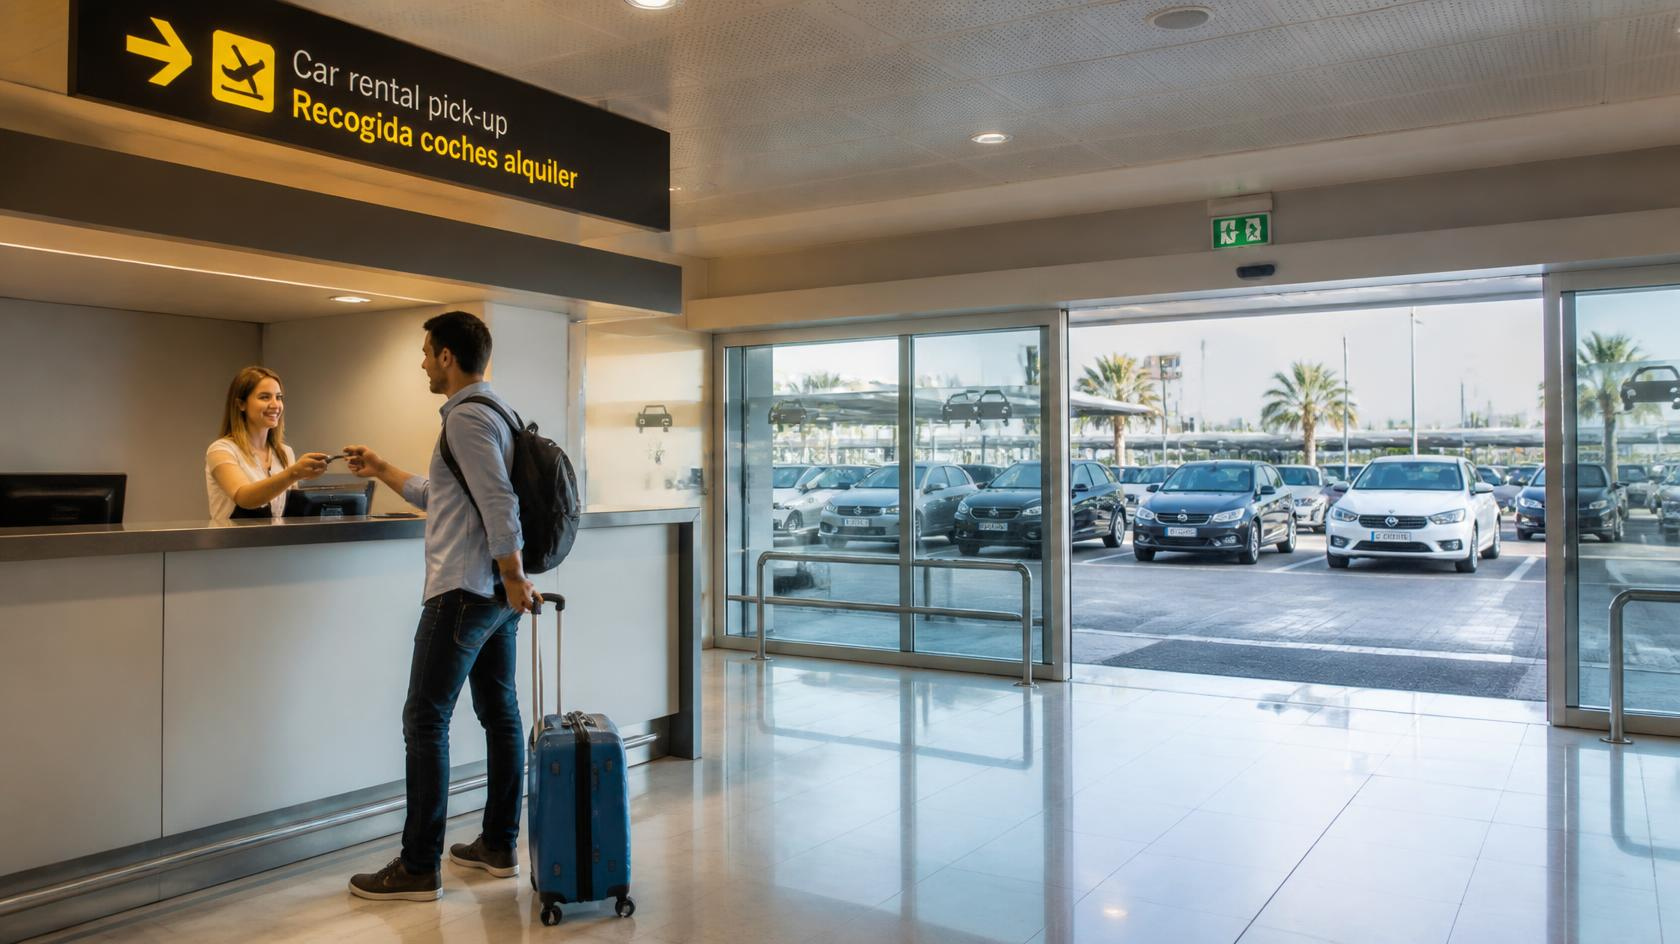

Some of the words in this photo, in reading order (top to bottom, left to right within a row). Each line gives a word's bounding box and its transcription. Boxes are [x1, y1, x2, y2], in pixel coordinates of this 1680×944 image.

[292, 88, 413, 147] Recogida
[420, 132, 499, 169] coches
[503, 149, 579, 190] alquiler
[293, 49, 340, 87] Car
[349, 71, 420, 111] rental
[428, 94, 508, 140] pick-up
